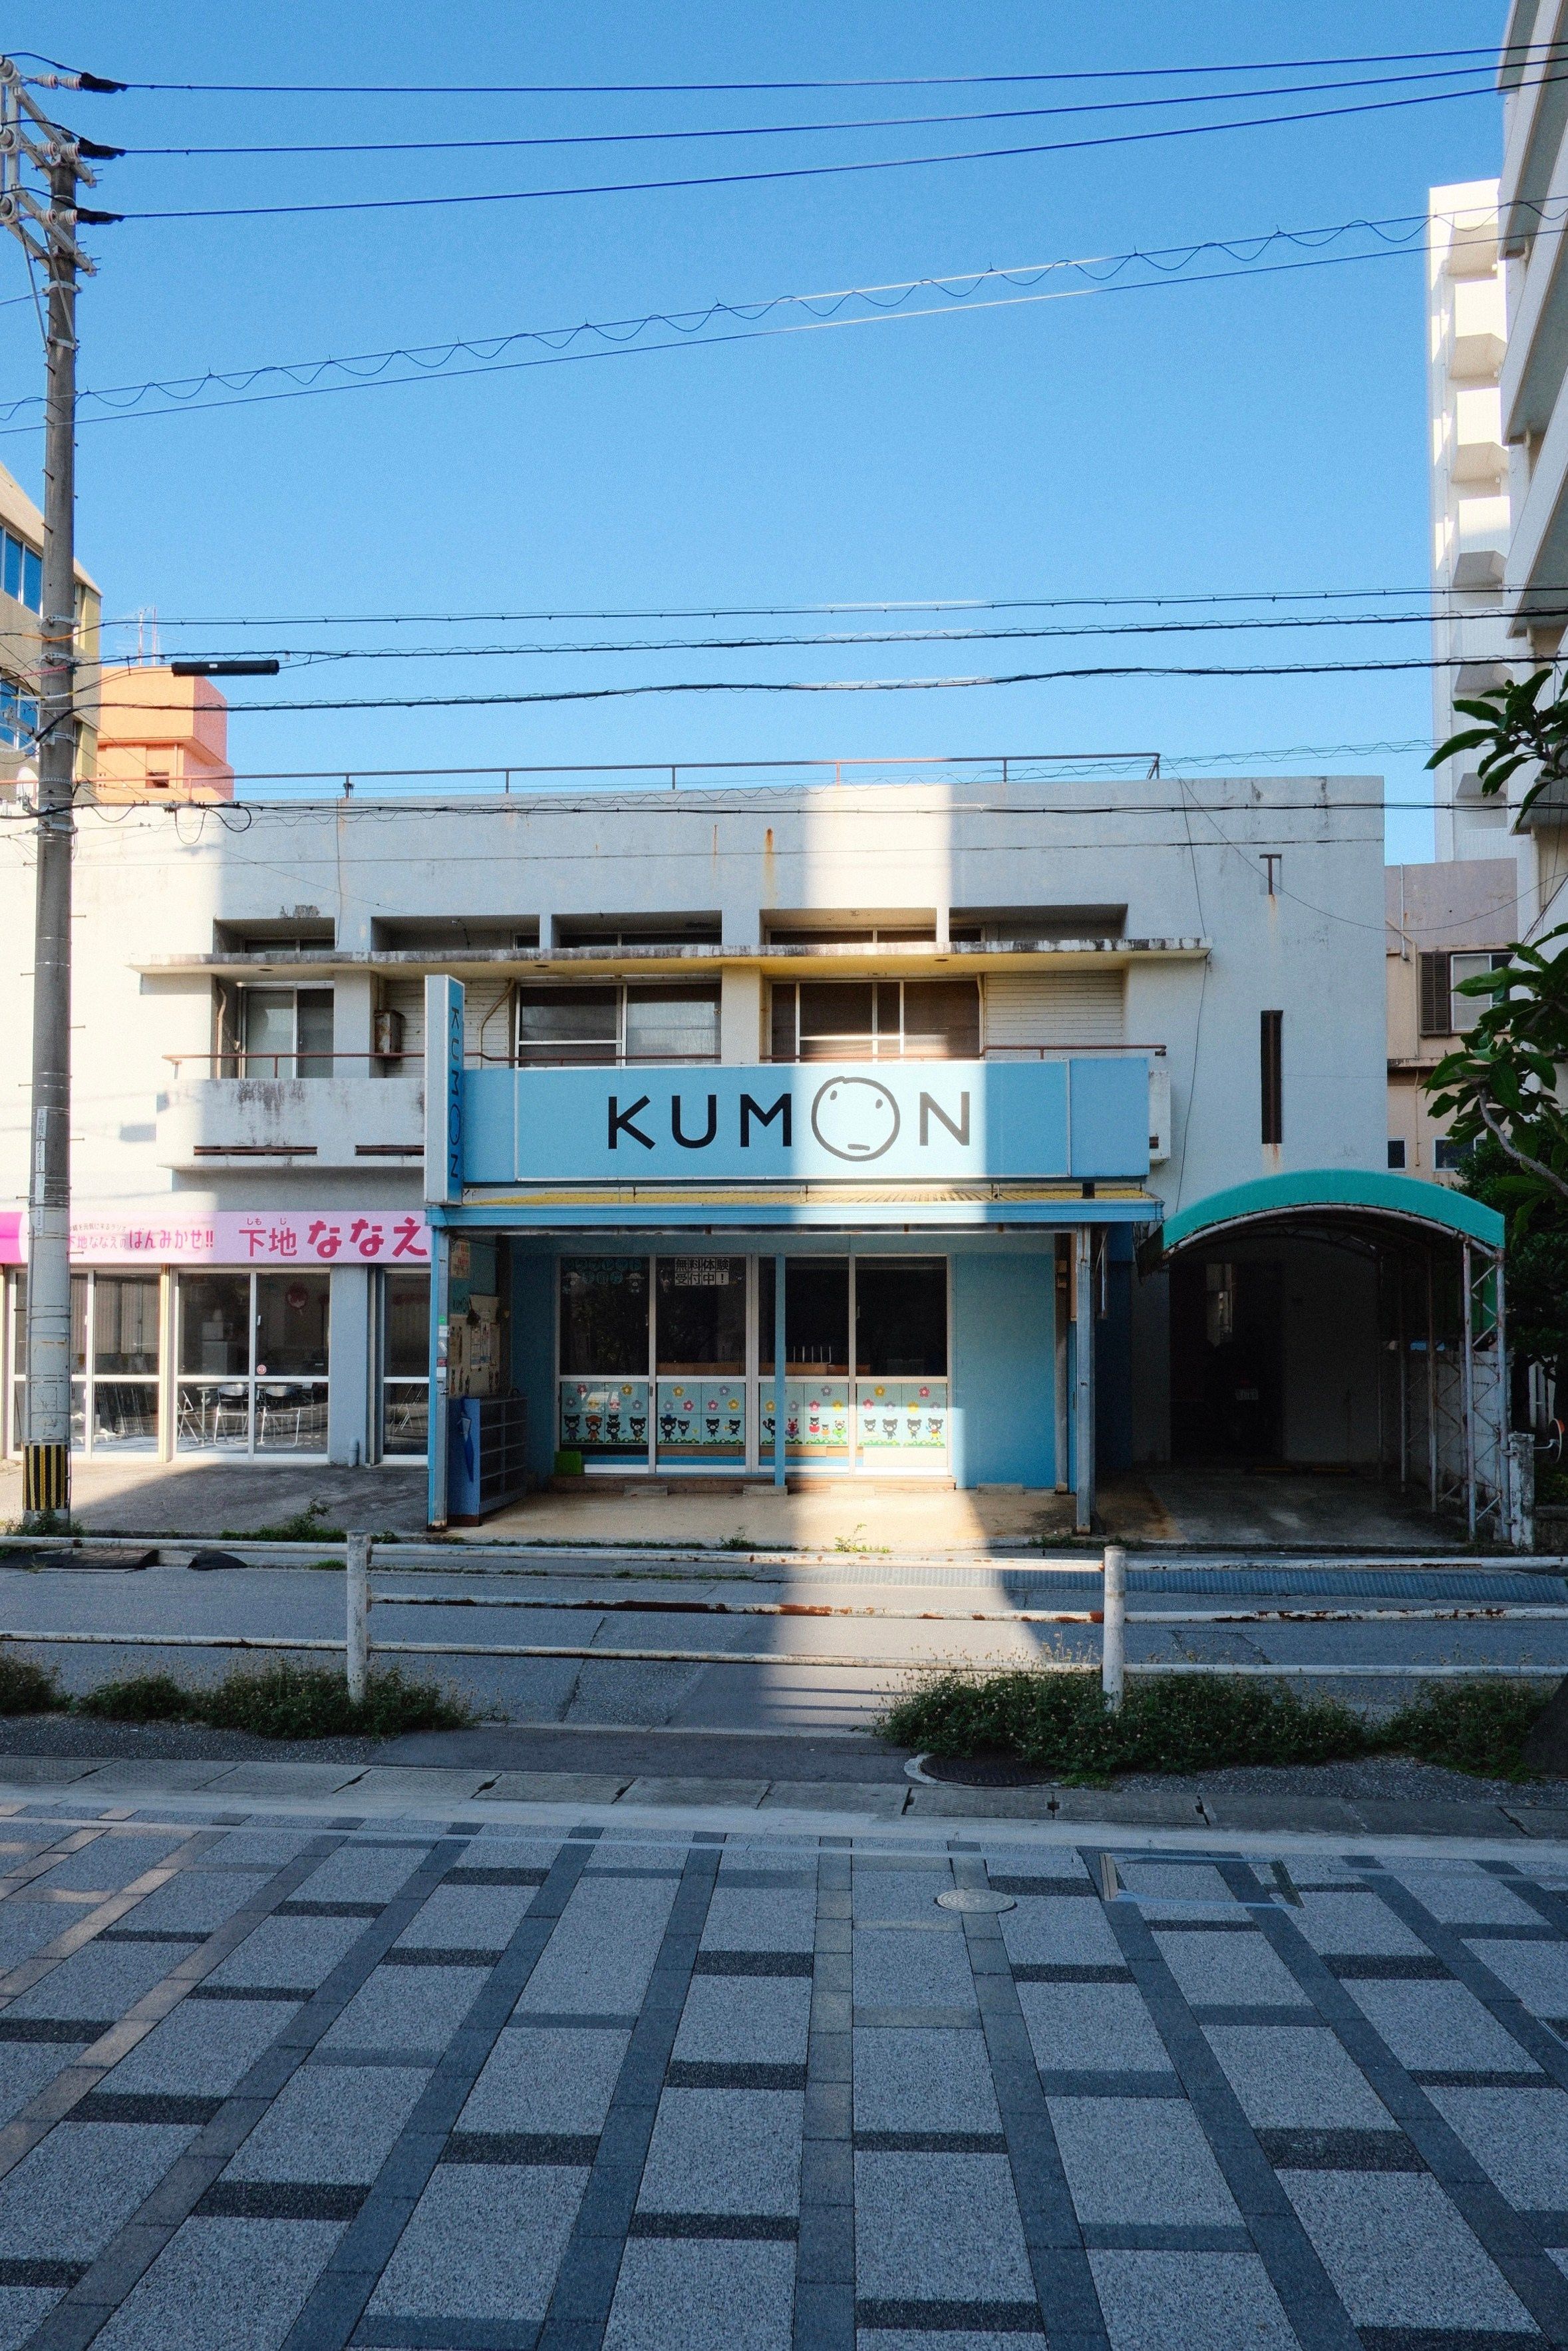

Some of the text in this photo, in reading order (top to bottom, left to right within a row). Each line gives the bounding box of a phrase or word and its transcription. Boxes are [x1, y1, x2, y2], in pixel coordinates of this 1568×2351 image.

[448, 1006, 461, 1178] KUMON
[608, 1076, 970, 1162] KUMON
[675, 1258, 729, 1271] 無料体験
